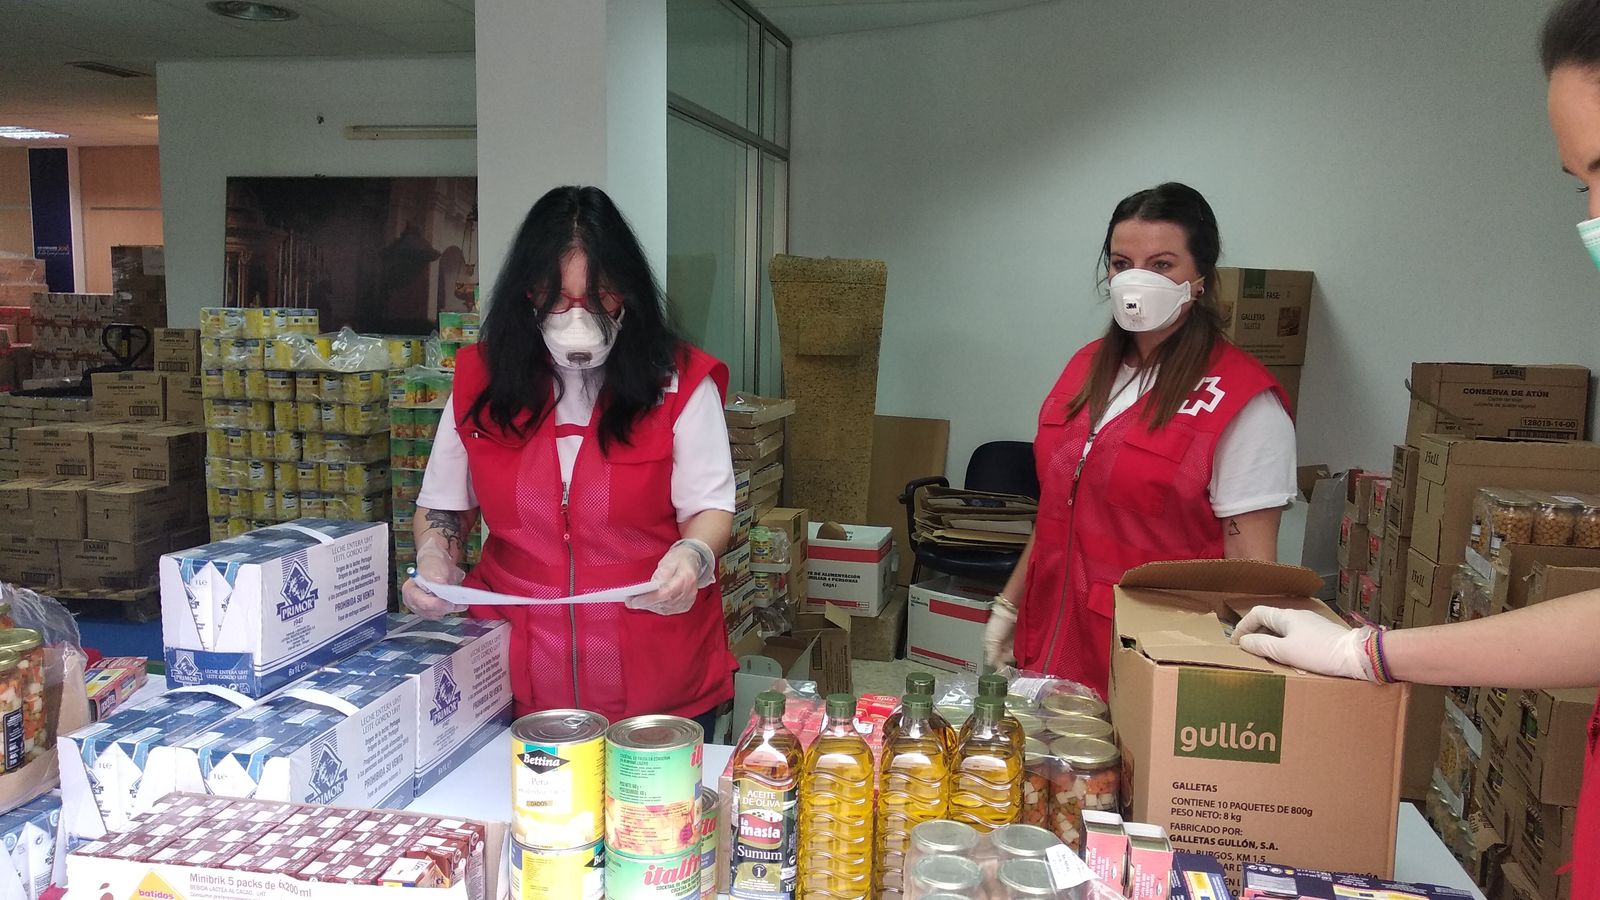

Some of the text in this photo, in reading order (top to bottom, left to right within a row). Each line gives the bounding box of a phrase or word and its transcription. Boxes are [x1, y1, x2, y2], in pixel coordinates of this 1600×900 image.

[1526, 389, 1549, 398] ATÚN
[332, 545, 345, 555] LECHE
[347, 539, 363, 552] ENTERA
[335, 588, 375, 612] PROHIBIDA SU VENTA
[282, 599, 314, 619] PRIMOR
[434, 704, 457, 724] PRIMOR
[1180, 722, 1276, 751] gullón
[523, 754, 560, 766] Bettina
[1172, 782, 1218, 792] GALLETAS
[747, 790, 776, 799] ACEITE
[743, 797, 780, 807] DE OLIVA
[1172, 797, 1313, 817] CONTIENE 10 PAQUETES DE 800g
[1170, 808, 1193, 816] PESO
[1196, 811, 1222, 819] NETO:
[1231, 813, 1242, 822] kg
[741, 826, 780, 838] masía
[1170, 822, 1243, 836] FABRICADO POR:
[1169, 834, 1278, 850] GALLETAS GULLÓN, S.A.
[738, 845, 782, 860] Sumum
[1236, 852, 1250, 861] KM
[1253, 854, 1266, 863] 1,5
[189, 873, 312, 897] Minibrik 5 packs de 6x200 ml
[138, 888, 174, 900] batidos
